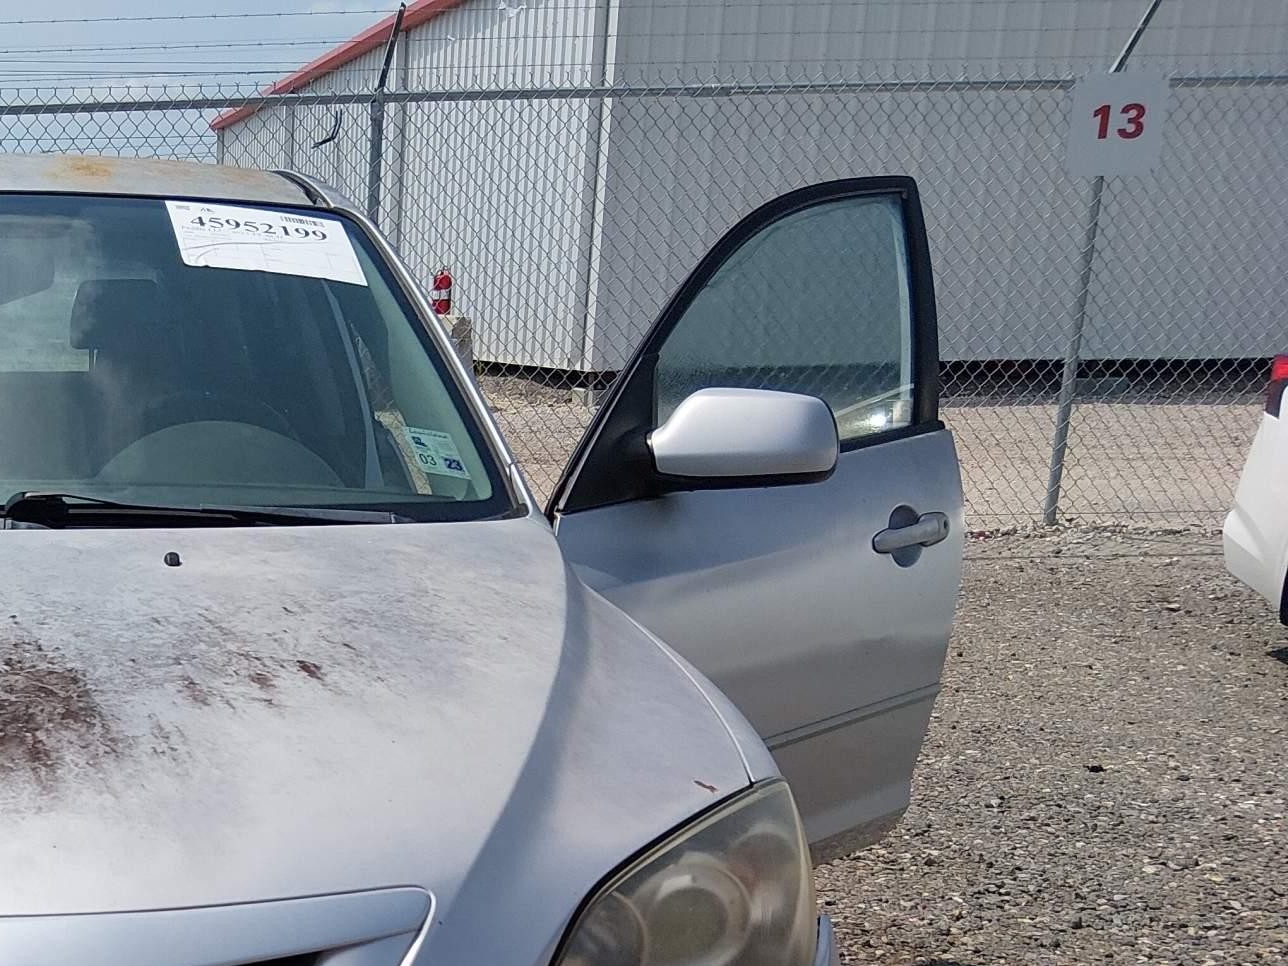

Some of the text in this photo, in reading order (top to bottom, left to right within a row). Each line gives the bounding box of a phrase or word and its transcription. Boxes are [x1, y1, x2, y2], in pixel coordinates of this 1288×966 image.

[1093, 103, 1146, 139] 13
[190, 215, 328, 241] 45952199
[419, 453, 463, 471] 03 23
